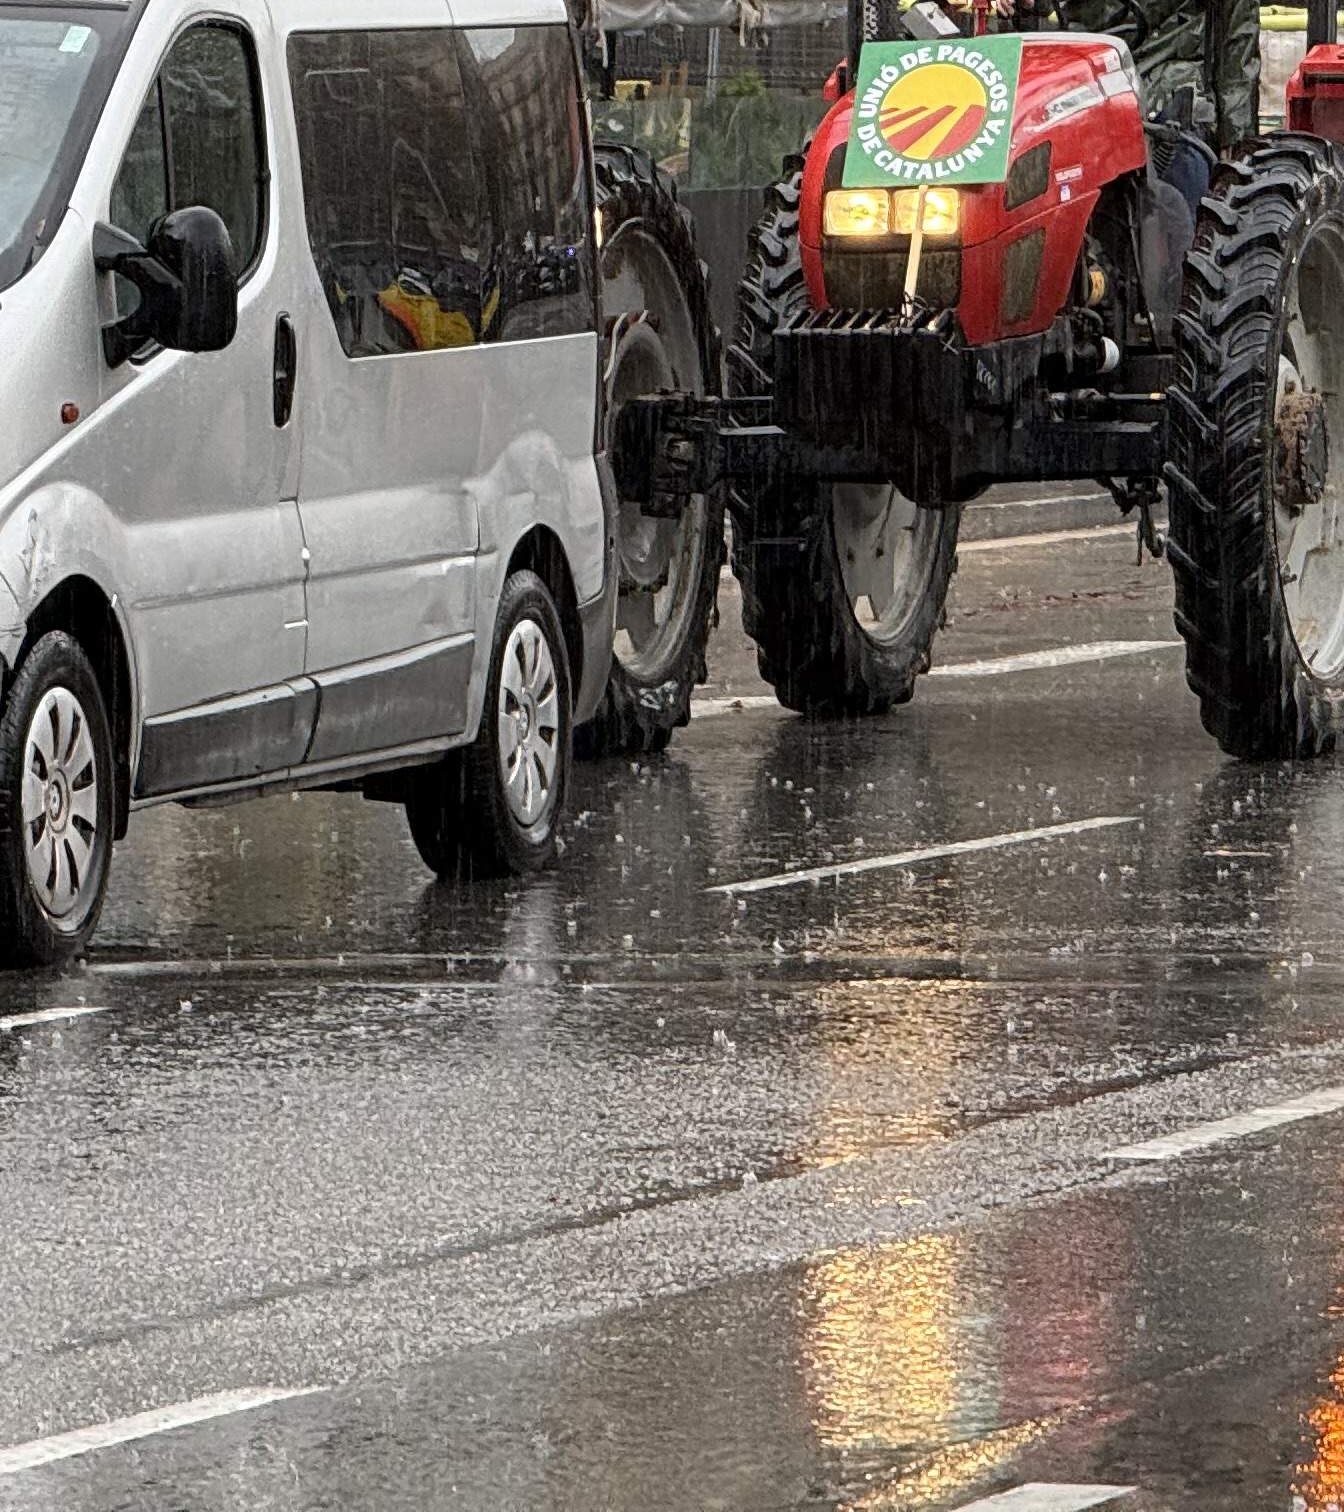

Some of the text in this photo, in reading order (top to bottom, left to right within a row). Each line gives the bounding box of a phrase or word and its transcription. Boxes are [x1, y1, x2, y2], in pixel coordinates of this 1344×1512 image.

[858, 64, 899, 118] UNIÓ
[899, 46, 933, 71] DE
[937, 44, 1009, 113] PAGESOS
[857, 118, 1006, 180] DE CATALUNYA
